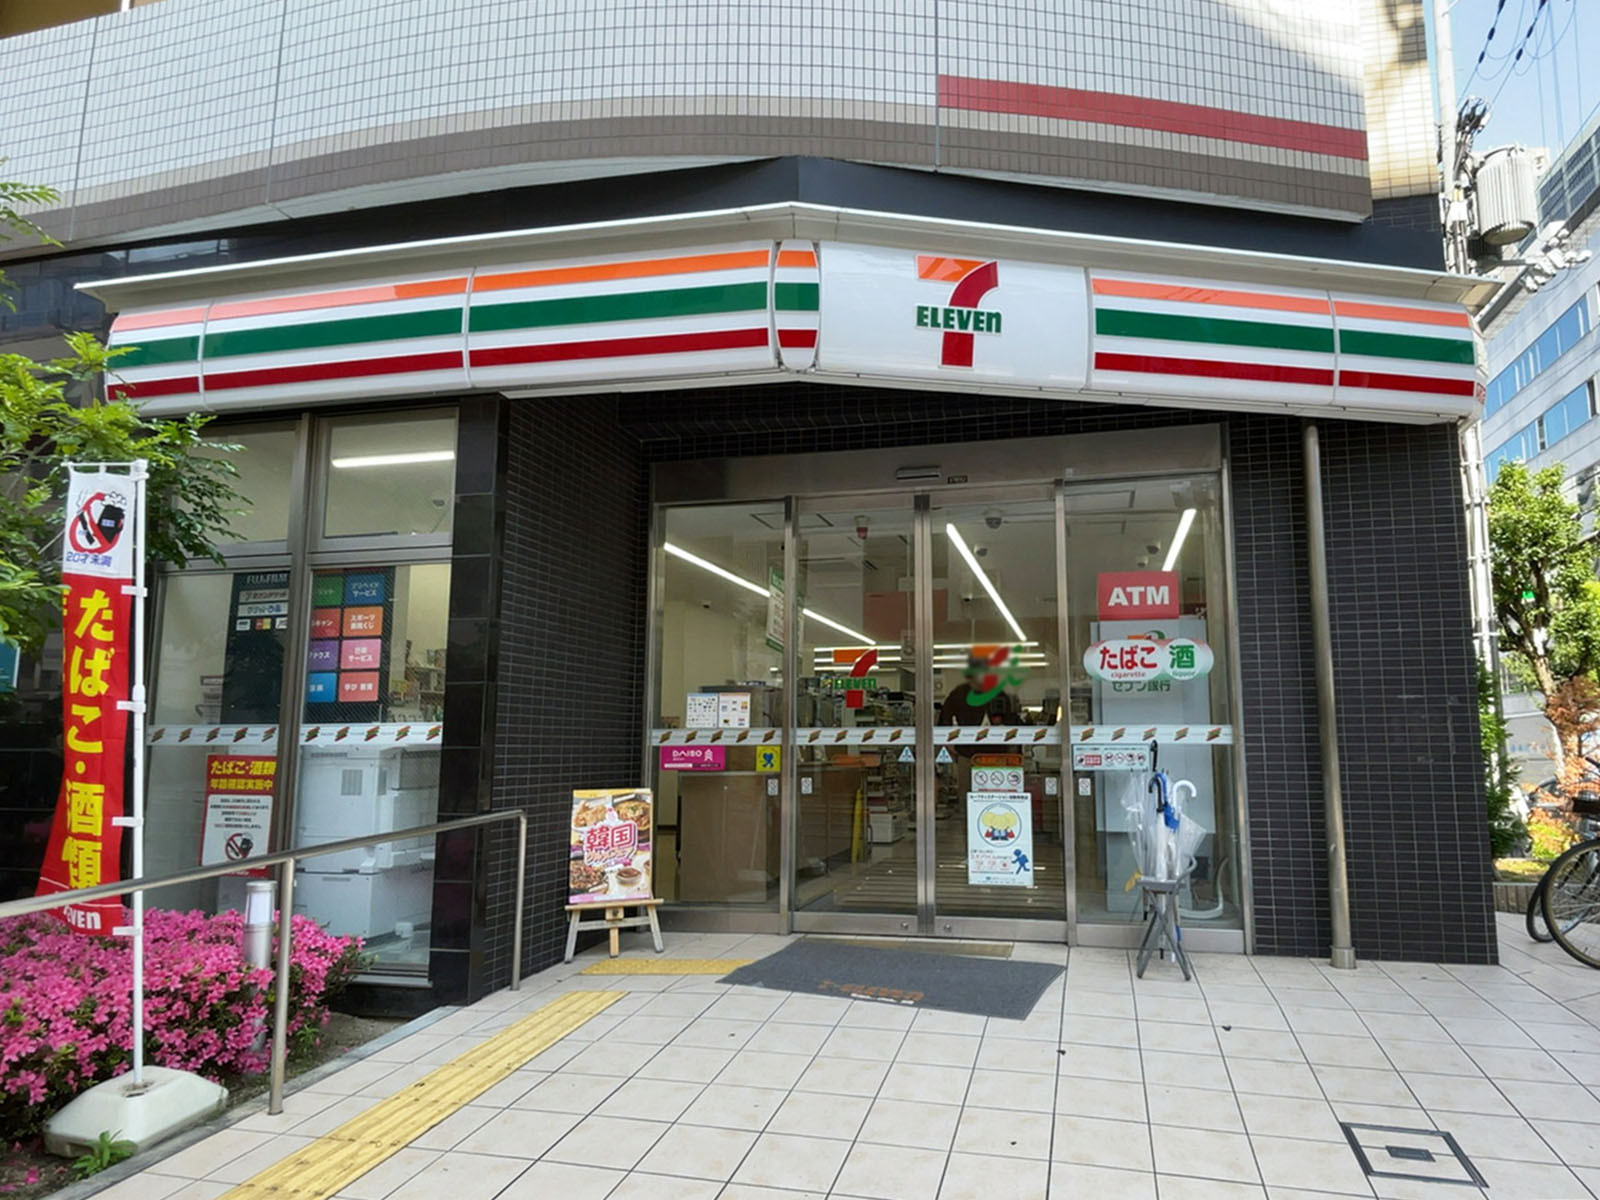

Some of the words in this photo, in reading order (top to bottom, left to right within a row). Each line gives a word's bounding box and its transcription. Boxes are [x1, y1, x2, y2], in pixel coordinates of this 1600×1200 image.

[1108, 585, 1170, 606] ATM
[1100, 644, 1158, 670] たばこ
[1169, 645, 1195, 669] 酒
[586, 823, 633, 851] 韓国
